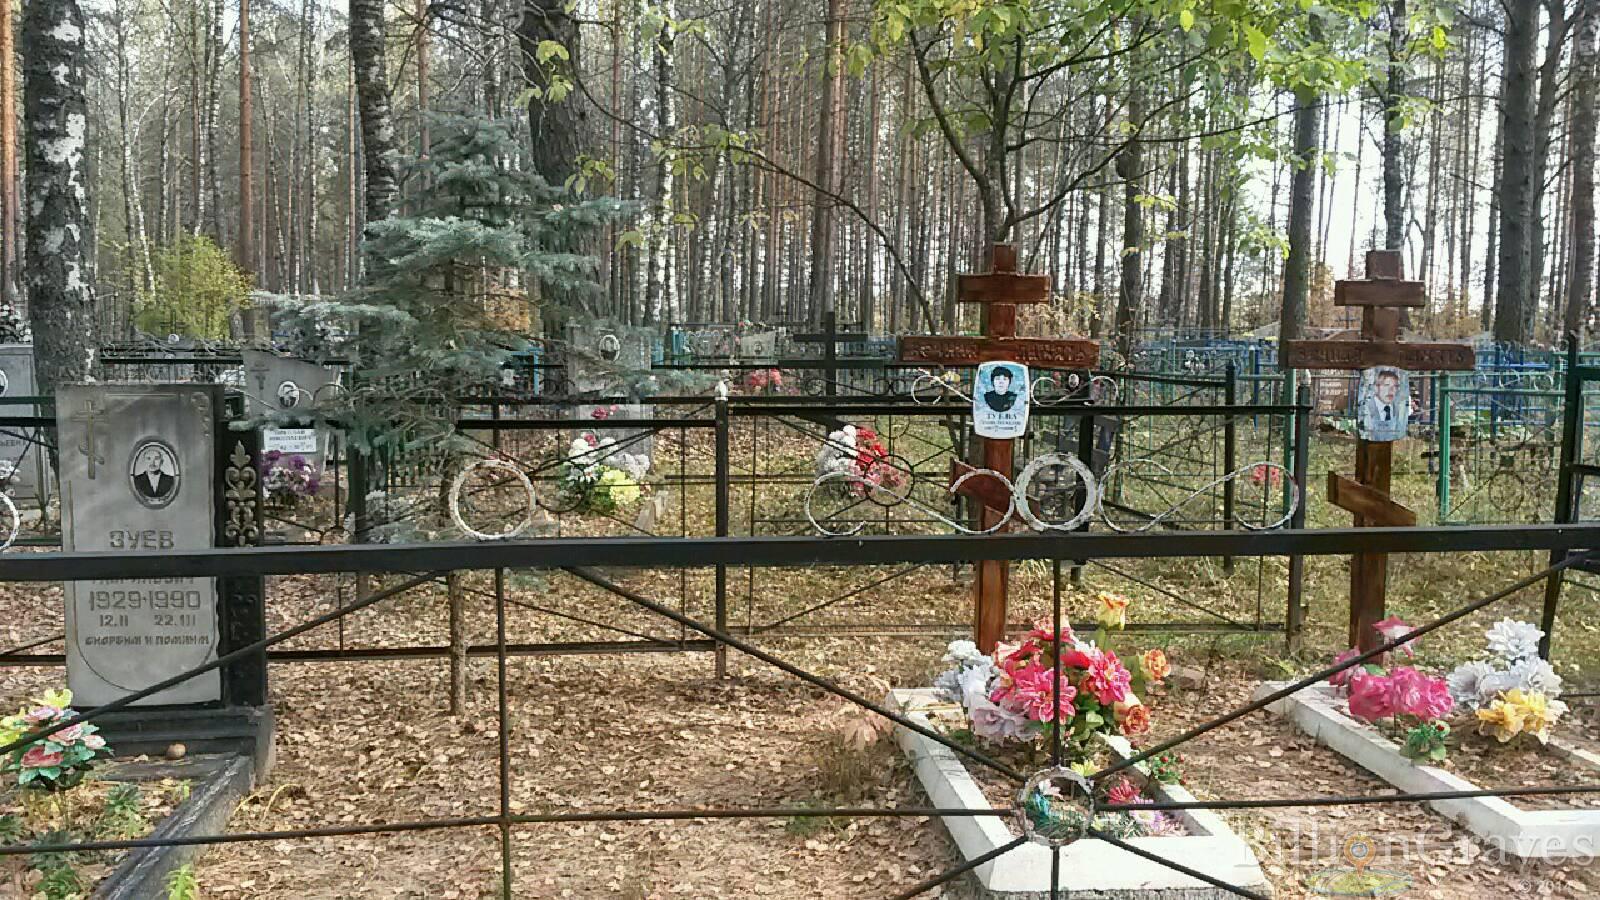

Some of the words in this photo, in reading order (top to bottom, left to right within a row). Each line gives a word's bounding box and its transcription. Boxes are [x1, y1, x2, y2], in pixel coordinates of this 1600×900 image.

[109, 530, 174, 549] ЗУЕВ
[144, 635, 153, 645] И
[155, 635, 210, 645] ПОМНИМ
